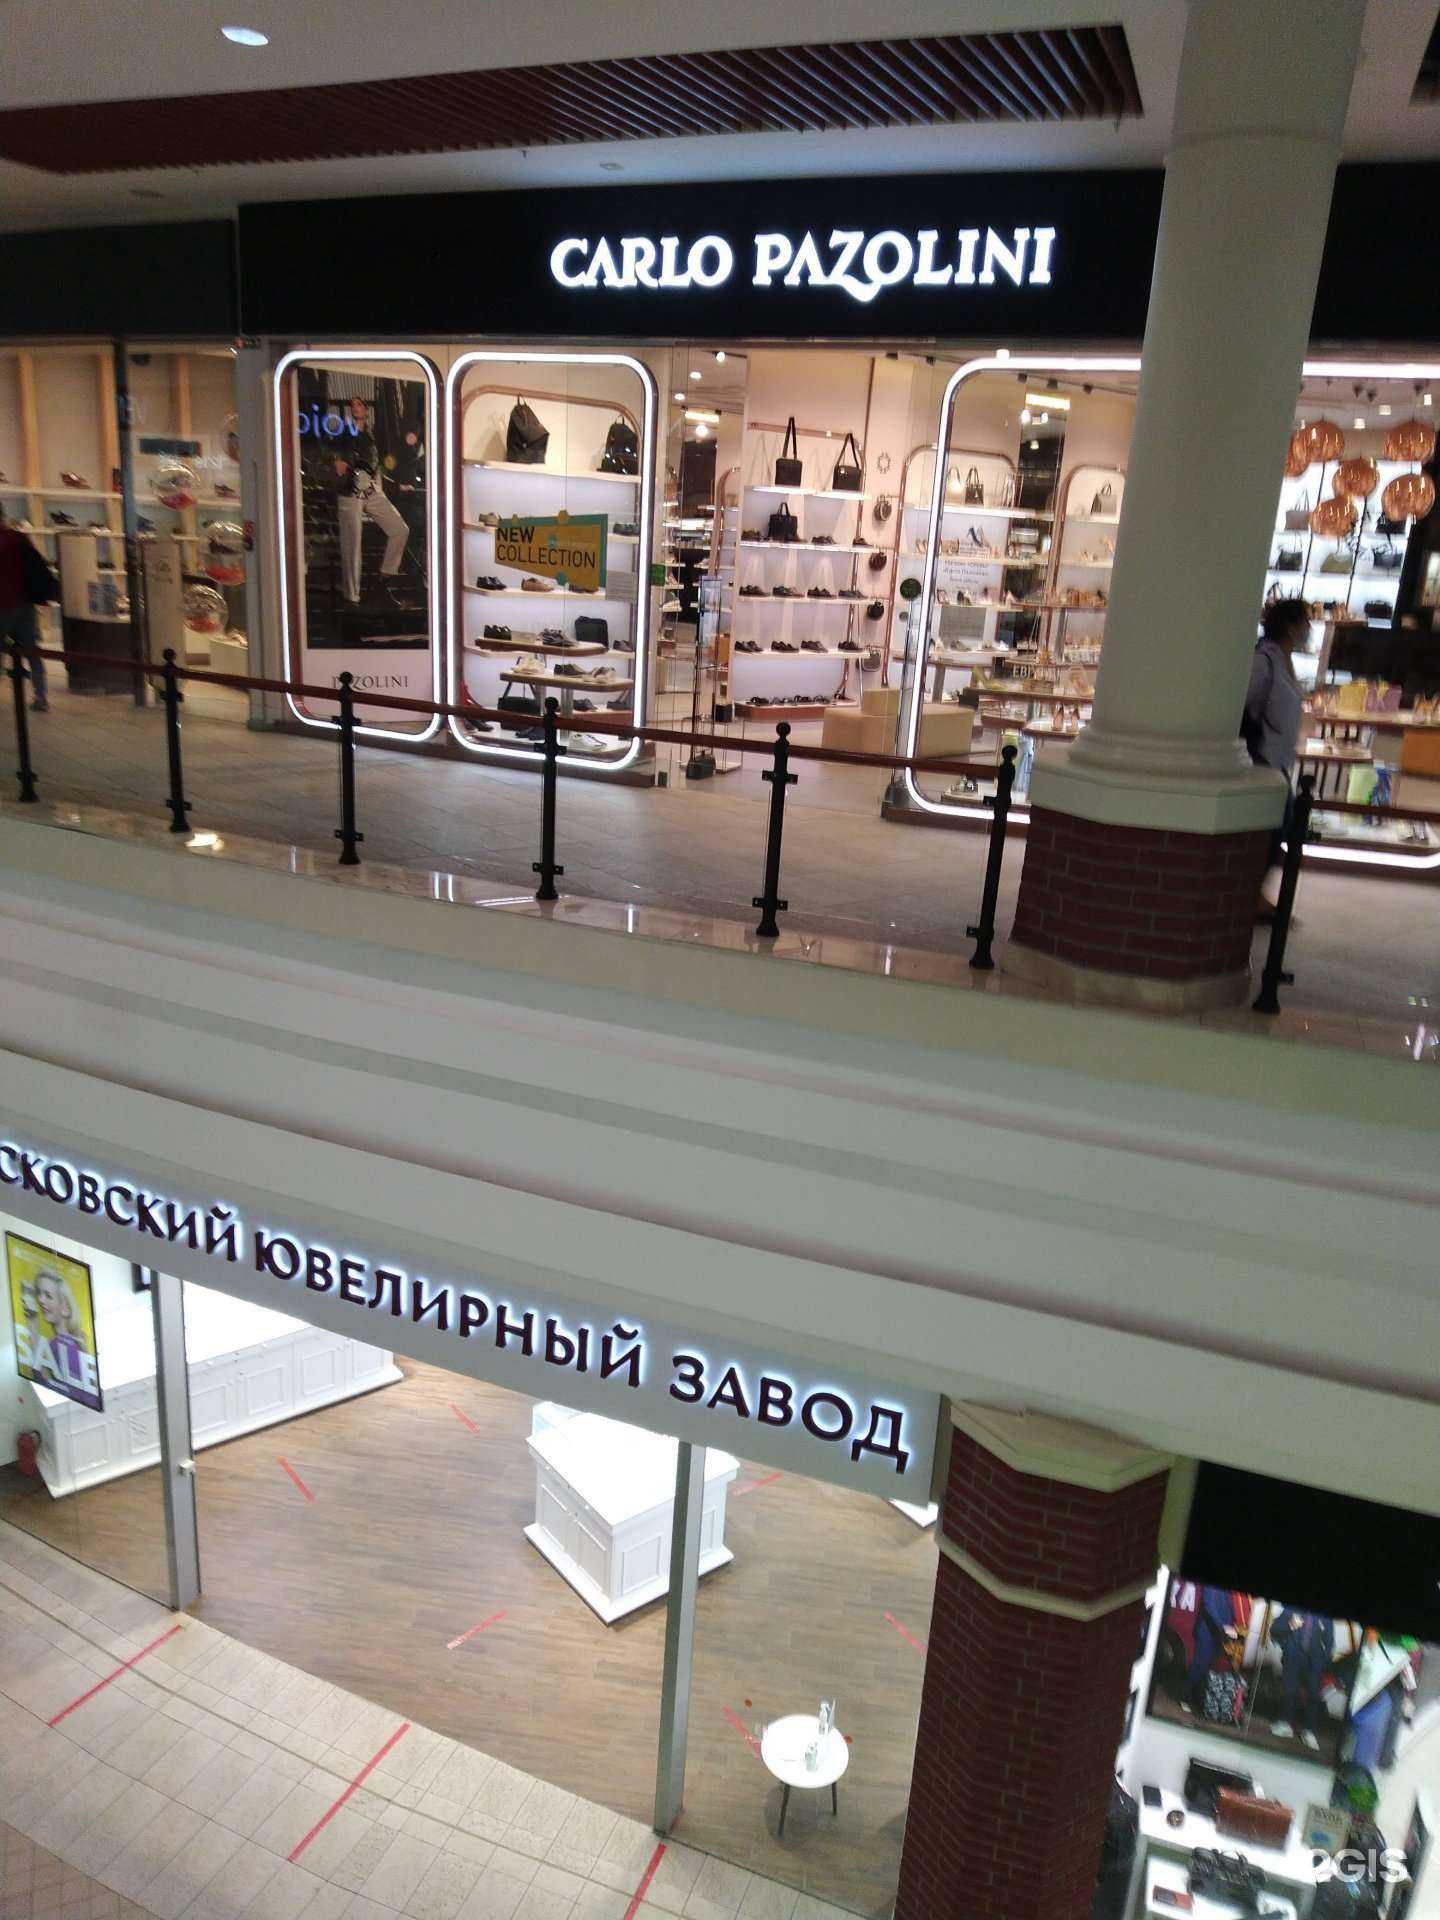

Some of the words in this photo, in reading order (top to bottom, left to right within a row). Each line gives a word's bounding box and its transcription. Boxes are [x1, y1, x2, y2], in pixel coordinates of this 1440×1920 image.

[550, 235, 734, 287] CARLO
[752, 226, 1056, 302] PAZOLINI
[496, 544, 596, 569] COLLECTION
[497, 526, 535, 544] NEW
[332, 675, 408, 691] PZOLINI
[0, 1145, 238, 1262] СКОВСКИЙ
[254, 1230, 643, 1389] ЮВЕЛИРНЫЙ
[668, 1354, 910, 1475] ЗАВОД
[15, 1323, 100, 1397] SALE
